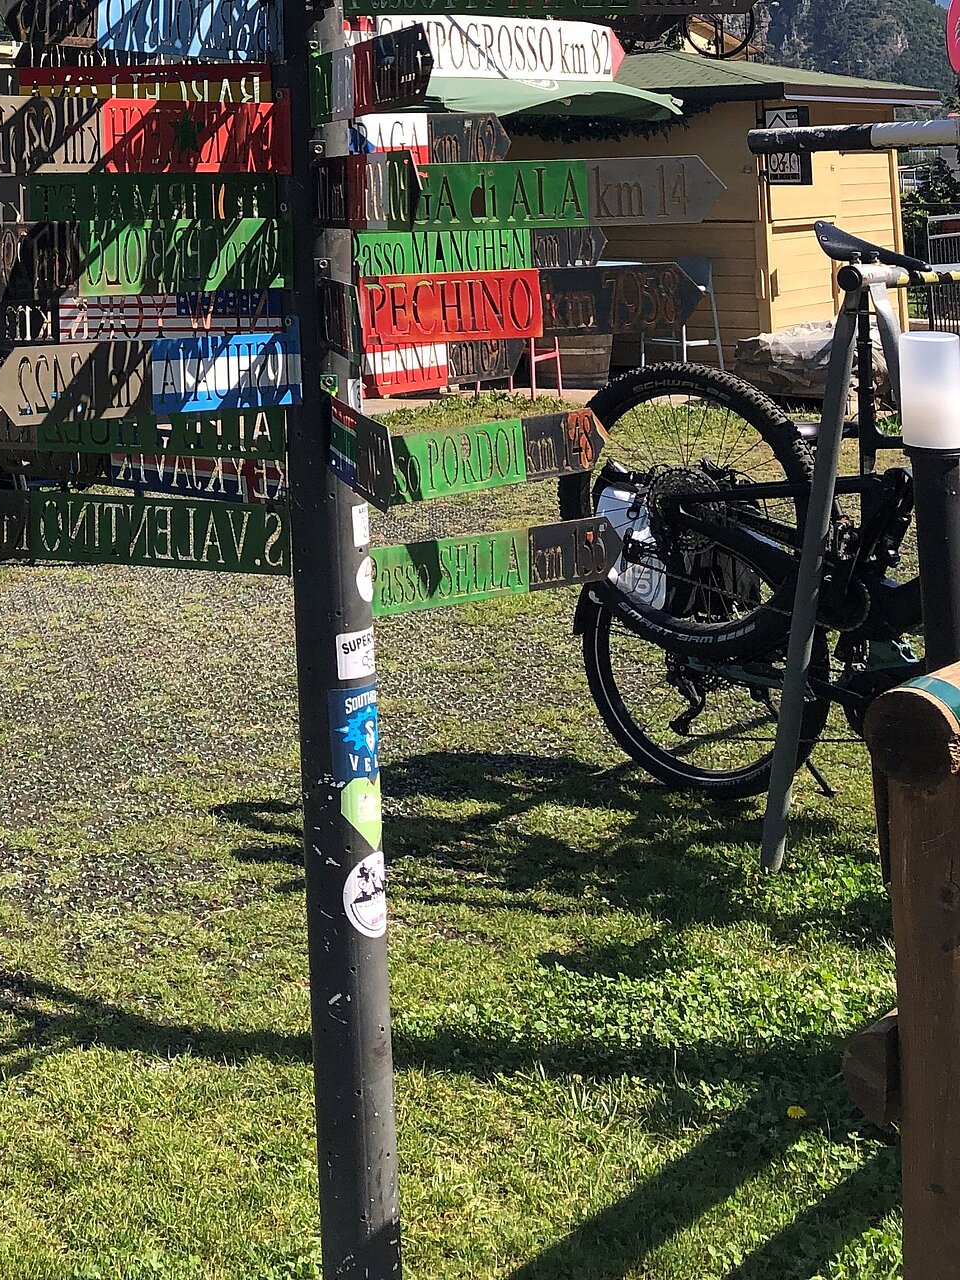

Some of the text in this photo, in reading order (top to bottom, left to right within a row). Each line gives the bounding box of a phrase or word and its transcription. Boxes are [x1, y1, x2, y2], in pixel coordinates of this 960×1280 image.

[559, 28, 588, 75] km
[591, 28, 613, 76] 82
[428, 120, 461, 164] km
[510, 166, 583, 222] ALA
[592, 165, 646, 220] km
[656, 163, 692, 218] 14
[410, 228, 531, 274] MANGHEN
[533, 228, 561, 268] km
[364, 276, 536, 337] PECHINO
[541, 275, 597, 331] km
[425, 425, 522, 492] PORDOI
[524, 424, 559, 475] km
[560, 413, 595, 472] 148
[438, 535, 524, 598] SELLA
[529, 532, 566, 586] km
[341, 631, 374, 656] SUPER
[617, 601, 715, 644] SMART SAM
